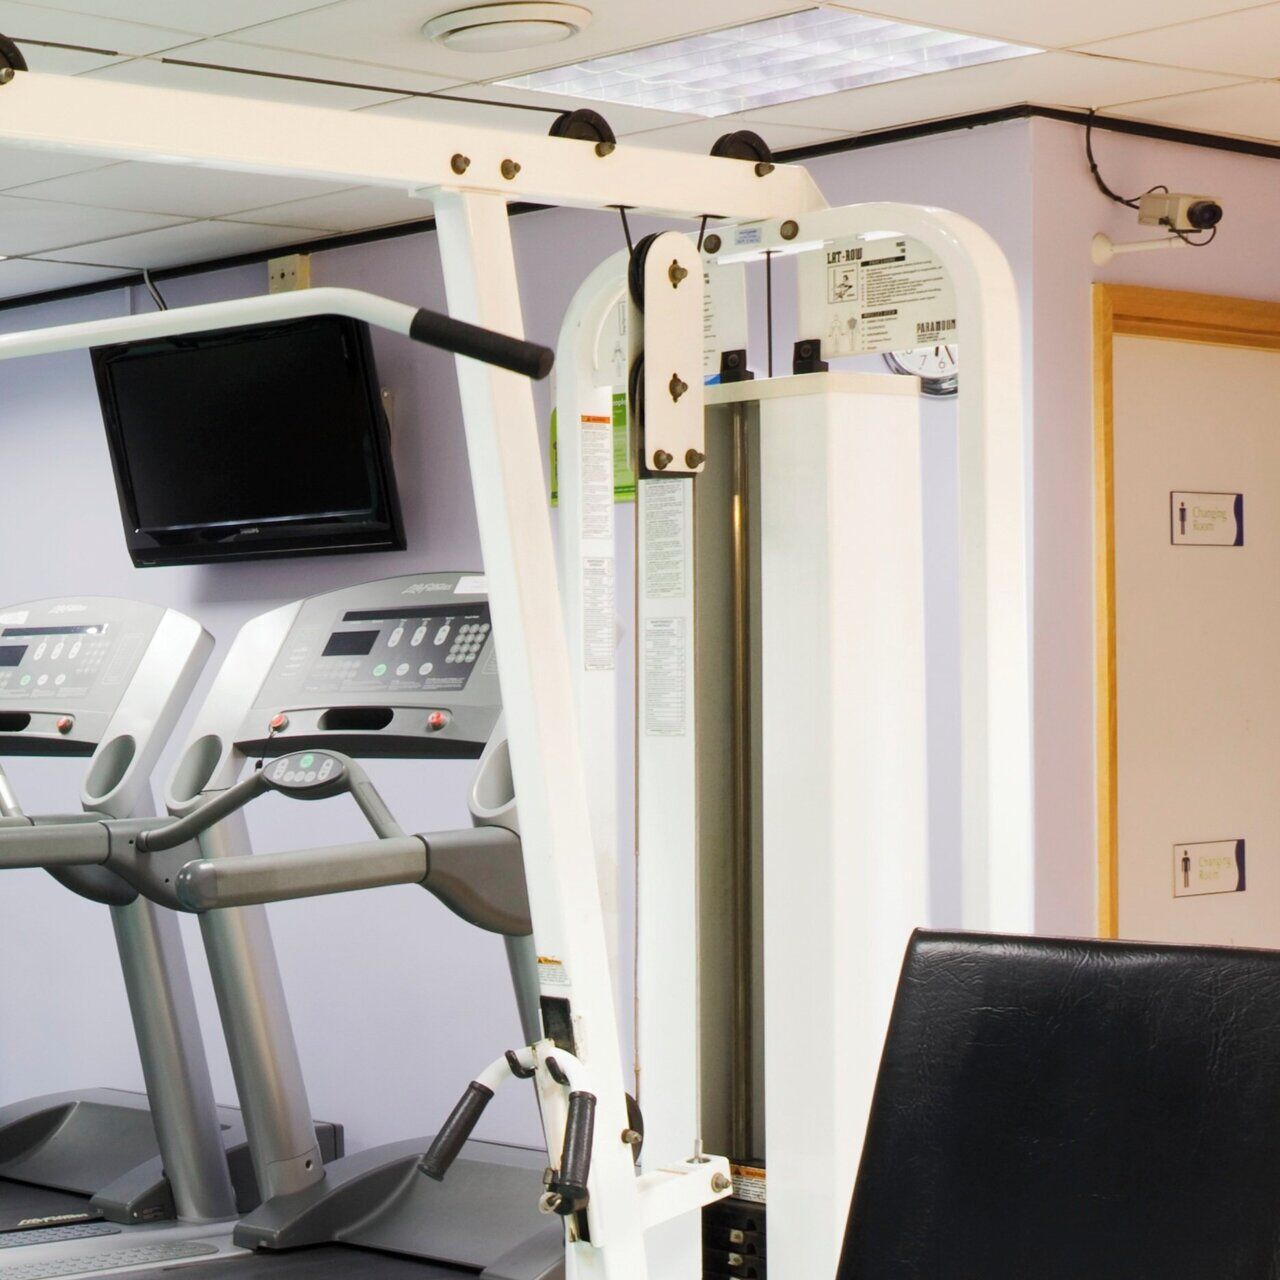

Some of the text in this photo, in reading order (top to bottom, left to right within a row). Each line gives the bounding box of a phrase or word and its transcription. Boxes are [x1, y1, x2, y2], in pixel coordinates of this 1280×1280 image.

[827, 248, 862, 264] LAT-ROW
[920, 354, 927, 366] 7
[939, 357, 946, 369] 6
